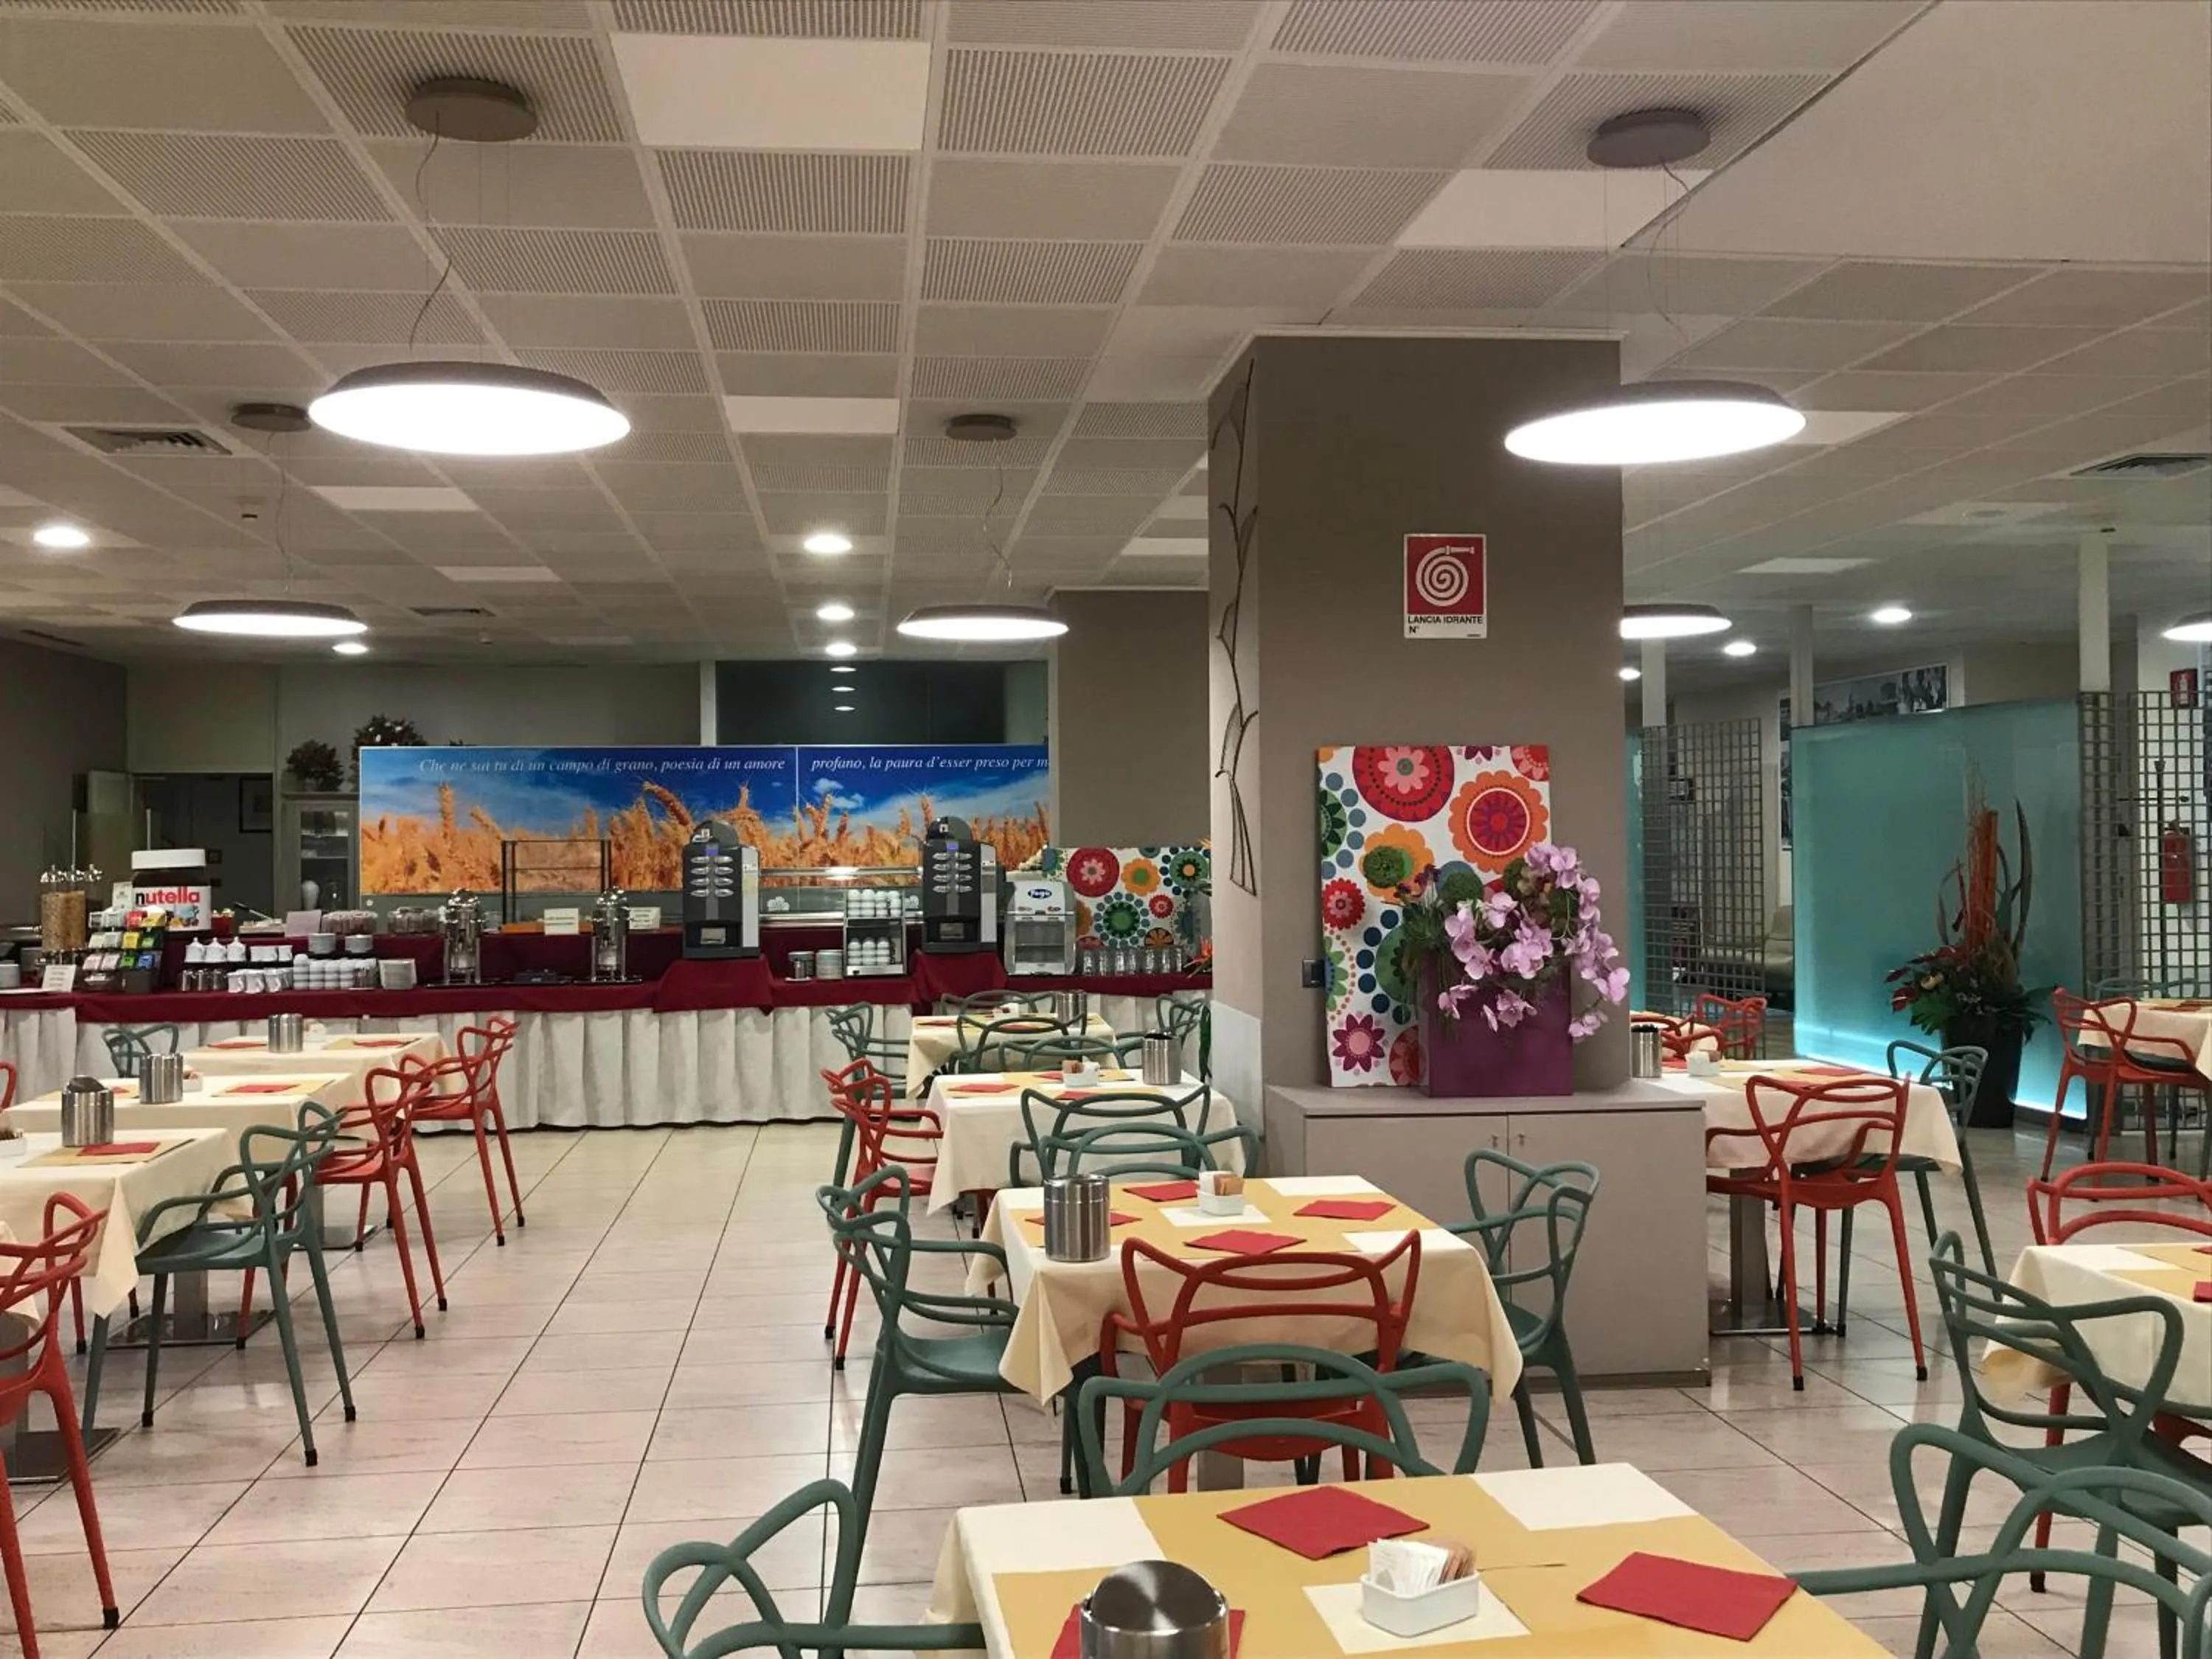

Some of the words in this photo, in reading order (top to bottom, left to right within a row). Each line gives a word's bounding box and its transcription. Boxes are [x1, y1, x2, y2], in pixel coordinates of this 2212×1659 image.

[1408, 616, 1441, 624] LANCIA
[1444, 616, 1484, 624] IDRANTE
[420, 759, 446, 772] Che
[451, 762, 467, 771] ne
[472, 760, 491, 772] sai
[511, 759, 525, 771] di
[528, 762, 546, 771] un
[549, 760, 594, 773] campo
[613, 760, 658, 773] grano,
[660, 757, 705, 773] poesia
[707, 757, 721, 771] di
[724, 760, 740, 771] un
[744, 760, 786, 770] amore
[811, 756, 866, 772] profano,
[869, 756, 882, 768] la
[884, 759, 923, 772] paura
[974, 759, 1009, 771] preso
[1012, 759, 1034, 771] per
[1036, 759, 1049, 768] m
[135, 885, 201, 905] nutella
